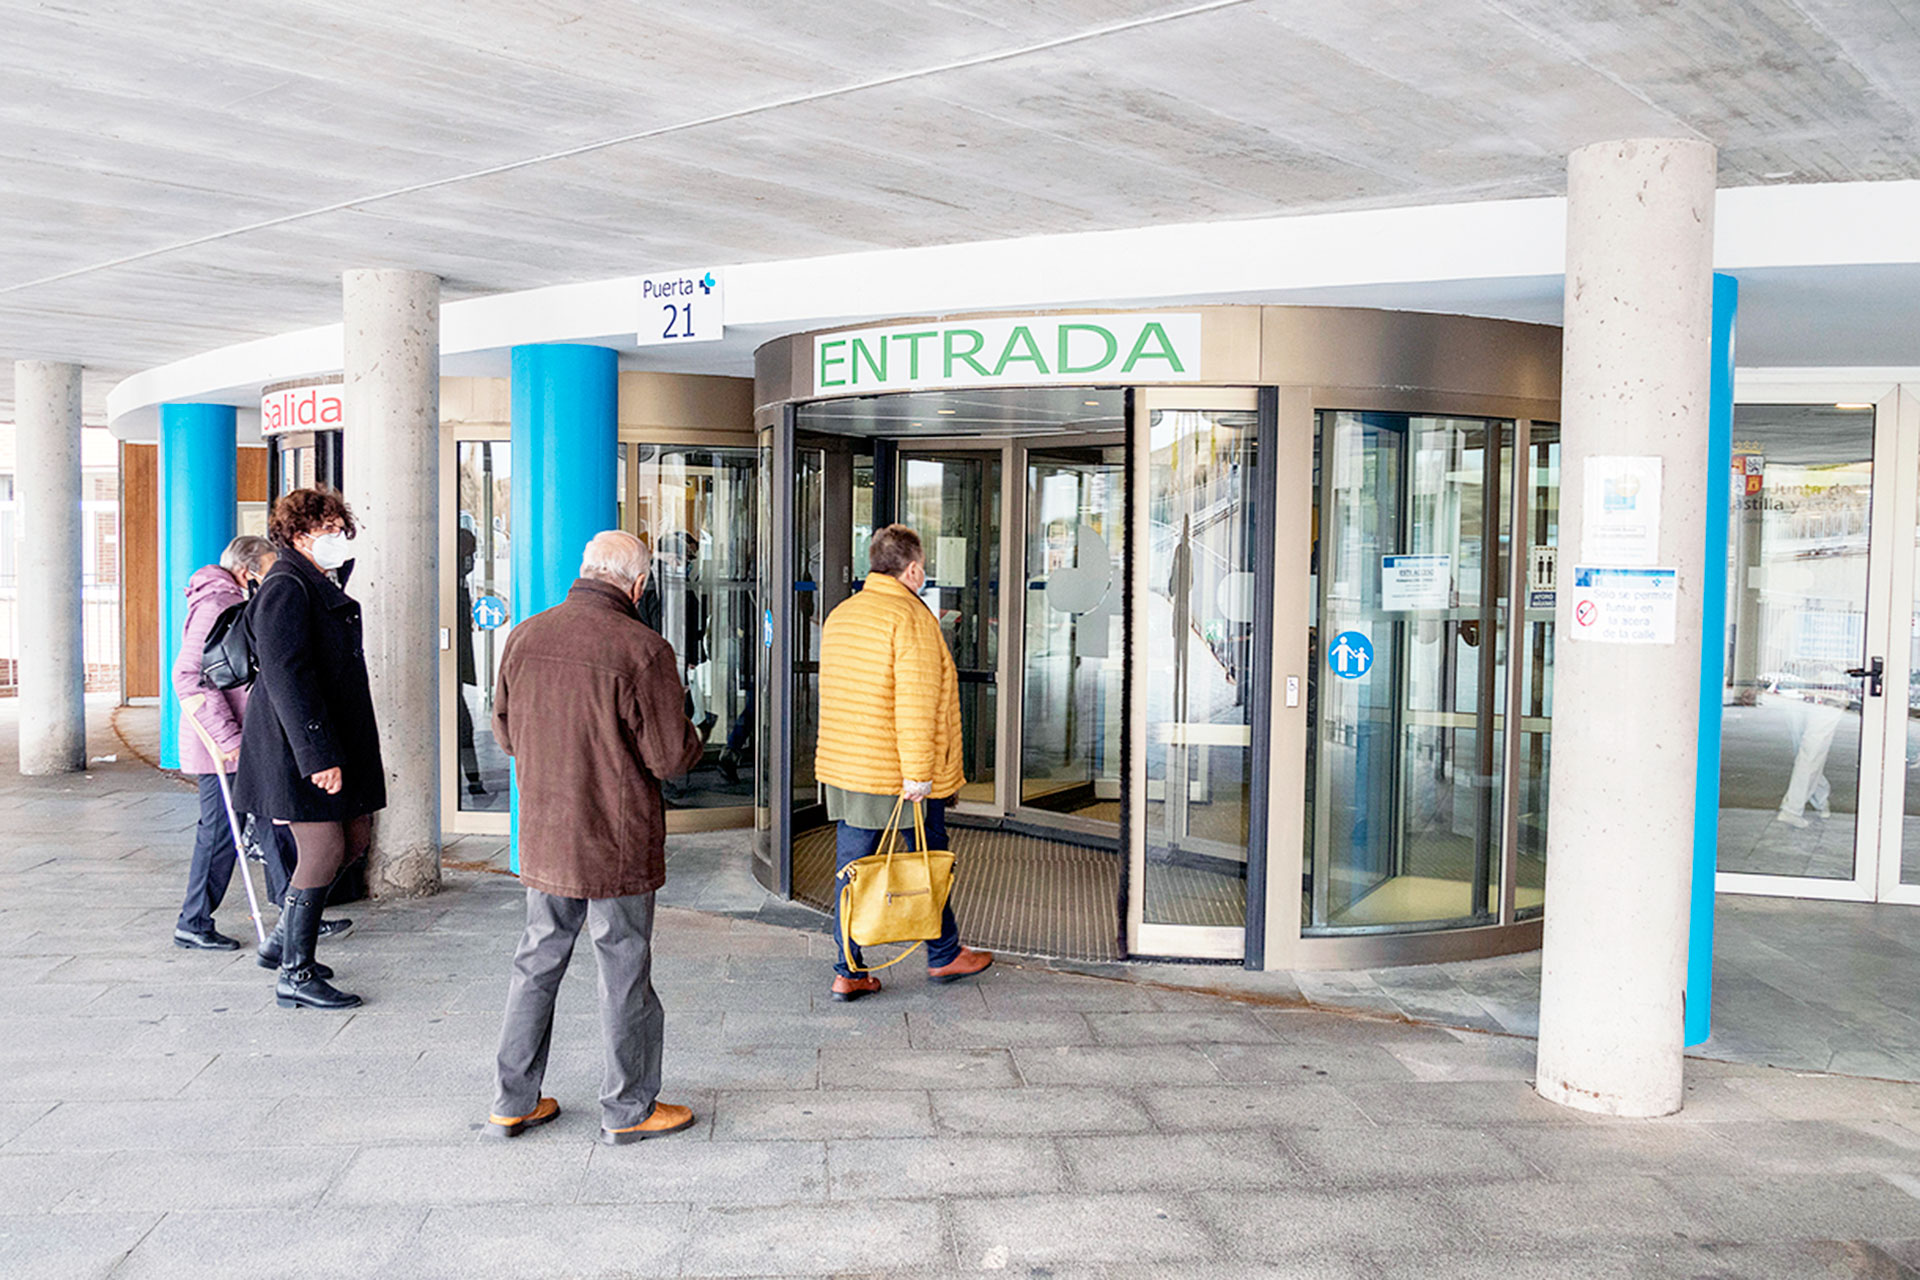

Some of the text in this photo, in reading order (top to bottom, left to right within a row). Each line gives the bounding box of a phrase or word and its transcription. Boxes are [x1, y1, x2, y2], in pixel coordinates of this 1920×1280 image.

[643, 277, 694, 298] Puerta
[663, 303, 695, 339] 21
[820, 322, 1185, 388] ENTRADA
[264, 390, 342, 431] Salida
[1730, 496, 1784, 511] astilla
